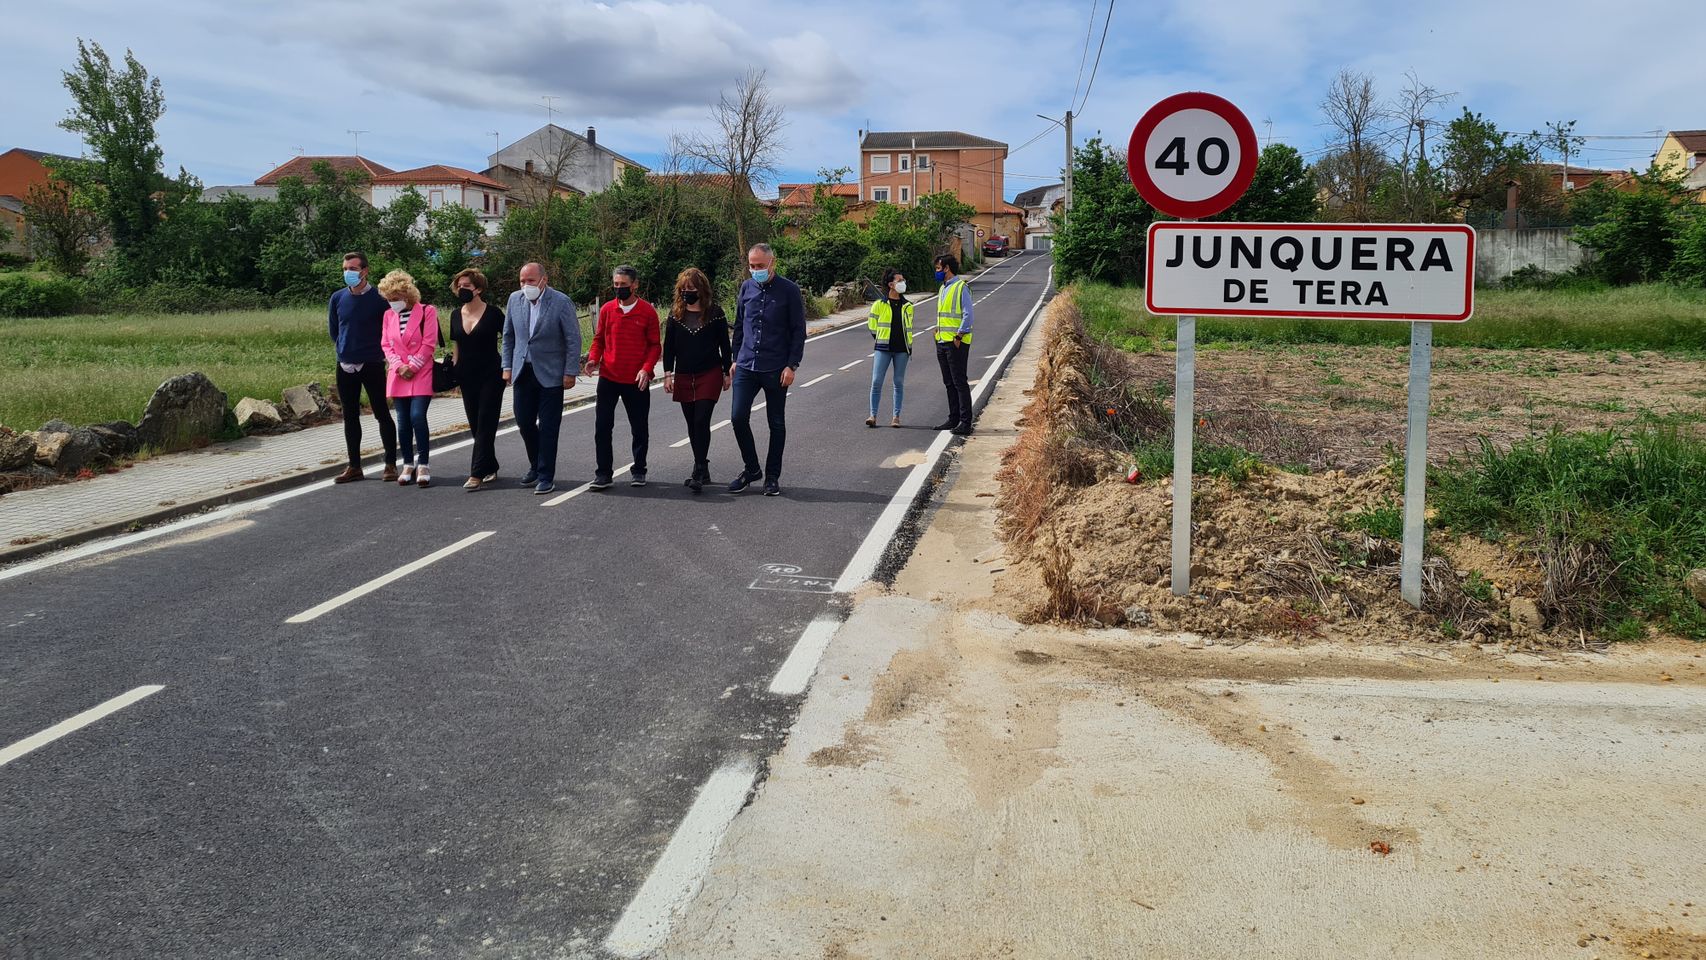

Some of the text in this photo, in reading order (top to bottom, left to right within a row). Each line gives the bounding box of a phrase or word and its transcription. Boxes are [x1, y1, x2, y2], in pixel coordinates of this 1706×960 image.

[1154, 136, 1230, 176] 40
[1165, 235, 1454, 273] JUNQUERA
[1223, 279, 1389, 307] DE TERA
